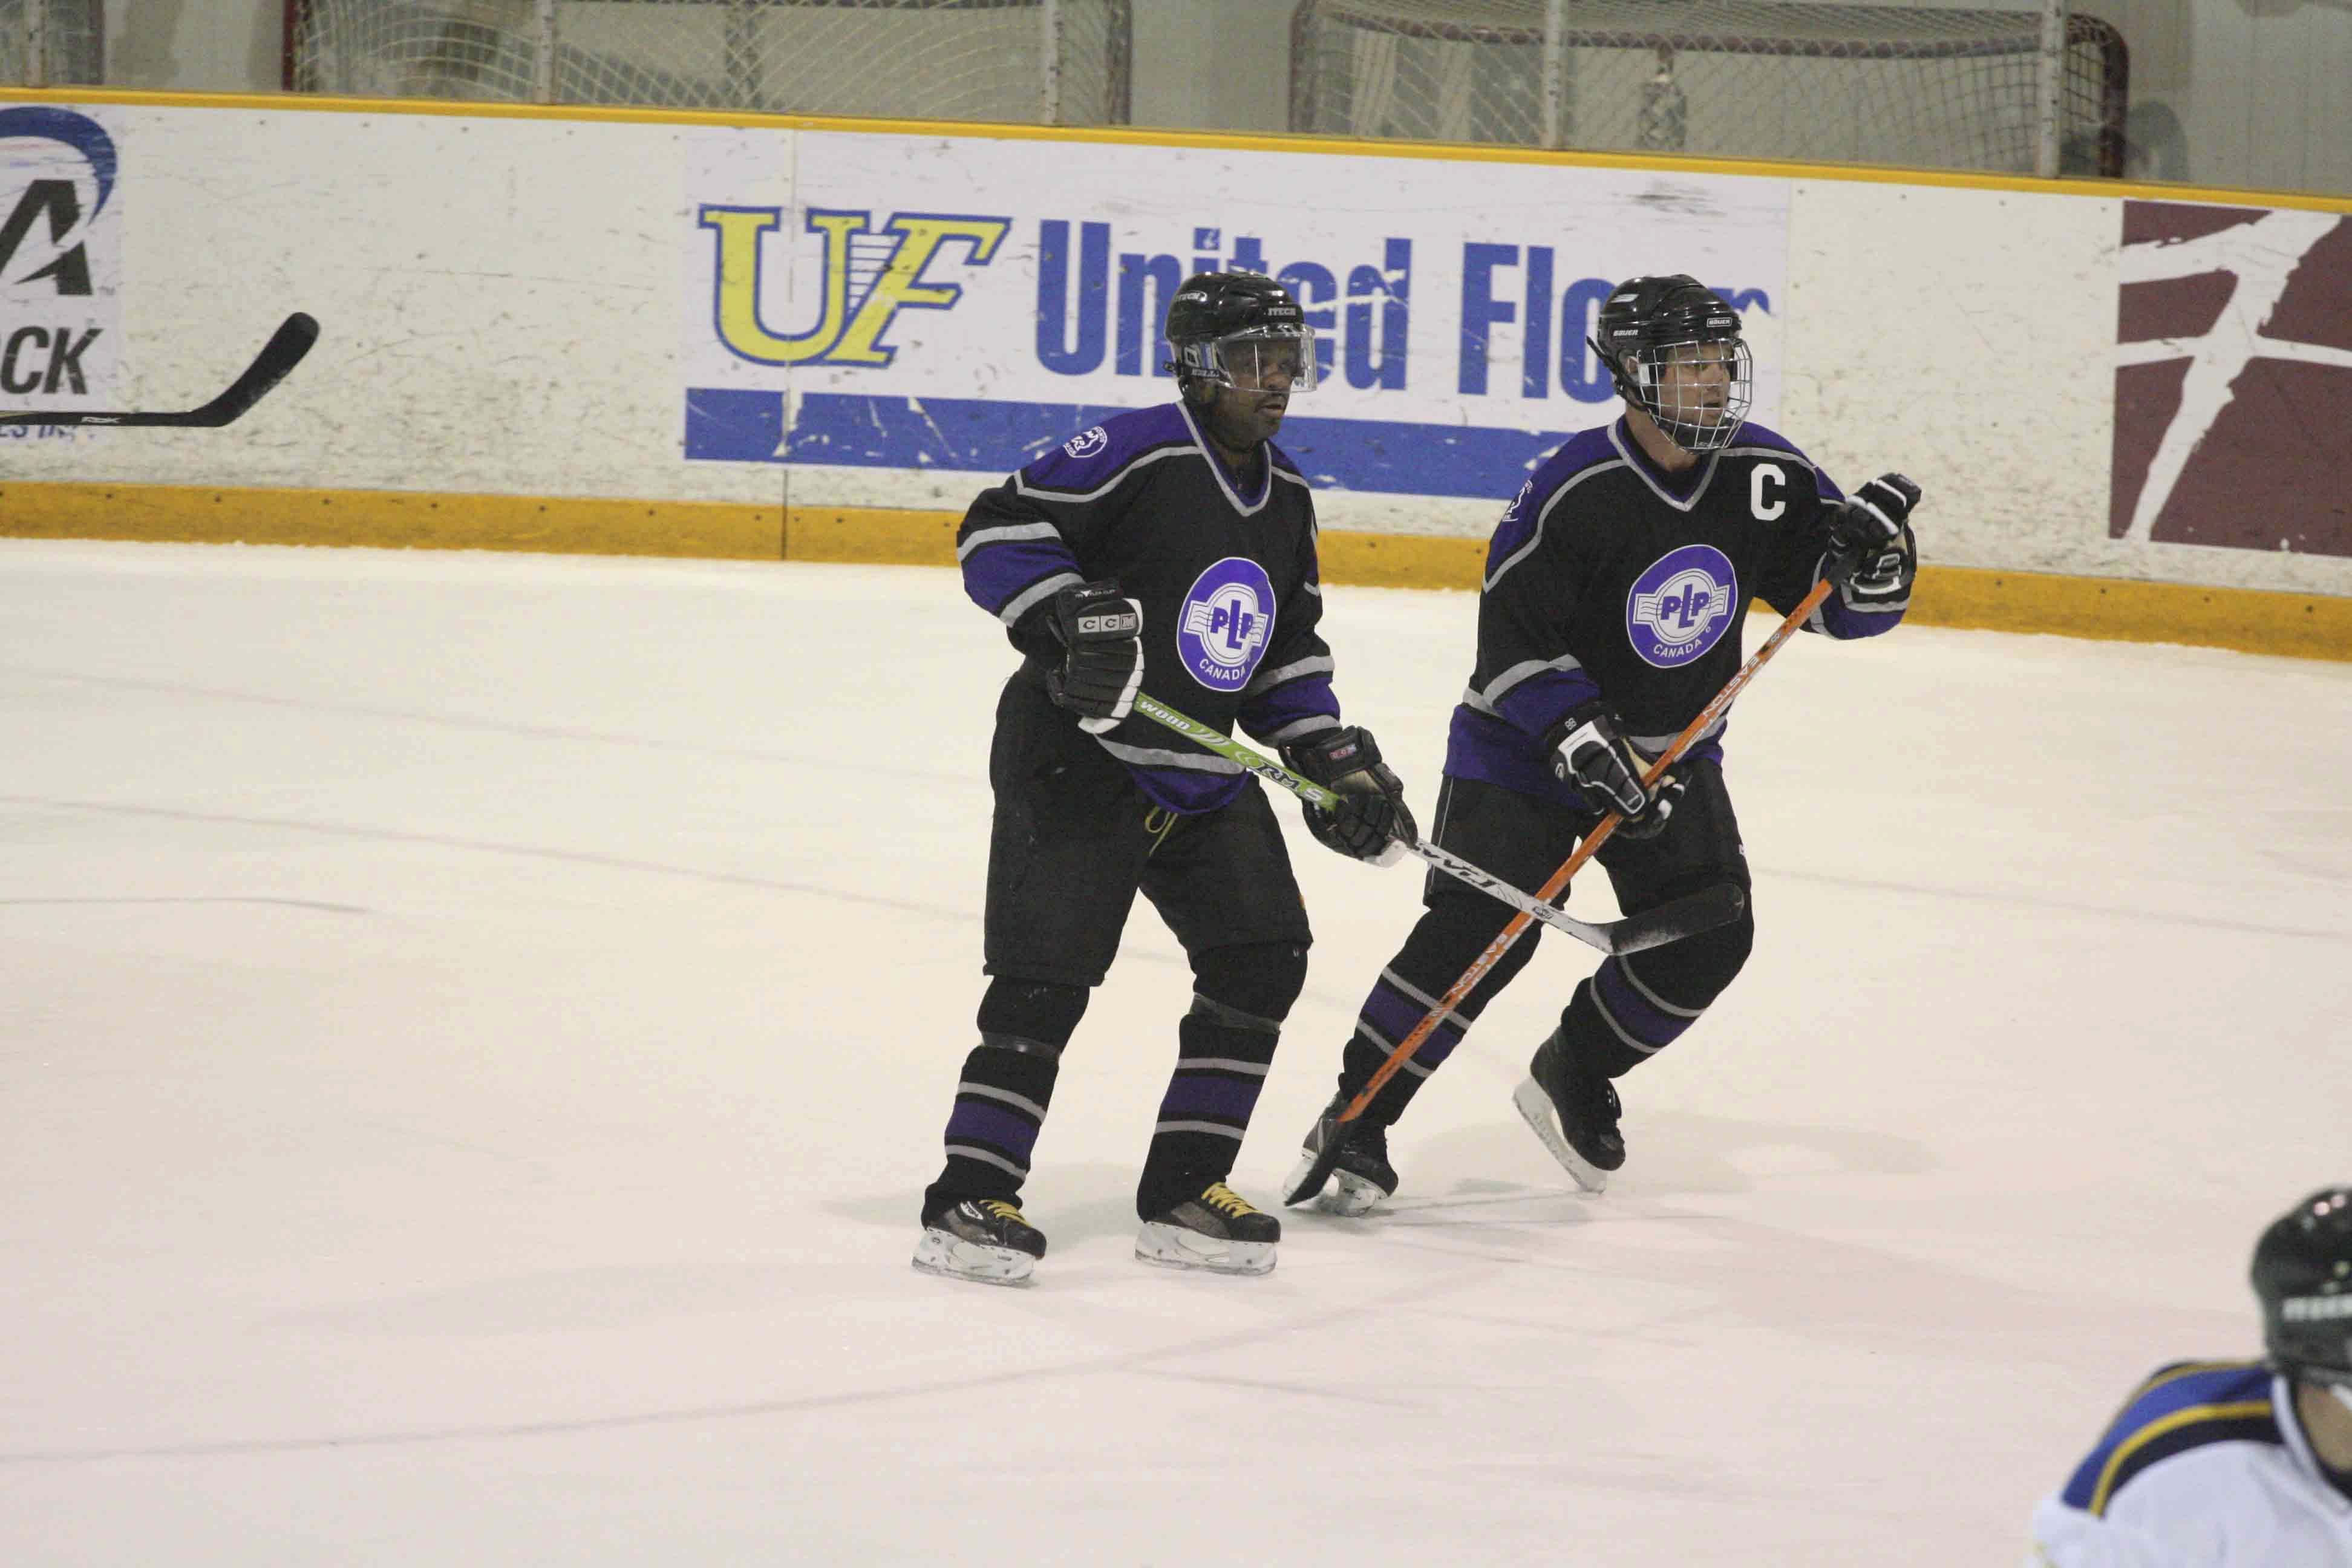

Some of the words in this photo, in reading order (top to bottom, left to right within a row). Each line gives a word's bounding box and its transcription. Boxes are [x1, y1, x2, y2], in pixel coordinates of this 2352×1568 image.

[1035, 218, 1413, 391] Uned
[1750, 463, 1786, 521] C
[1079, 613, 1135, 632] CCM
[1653, 638, 1703, 659] CANADA
